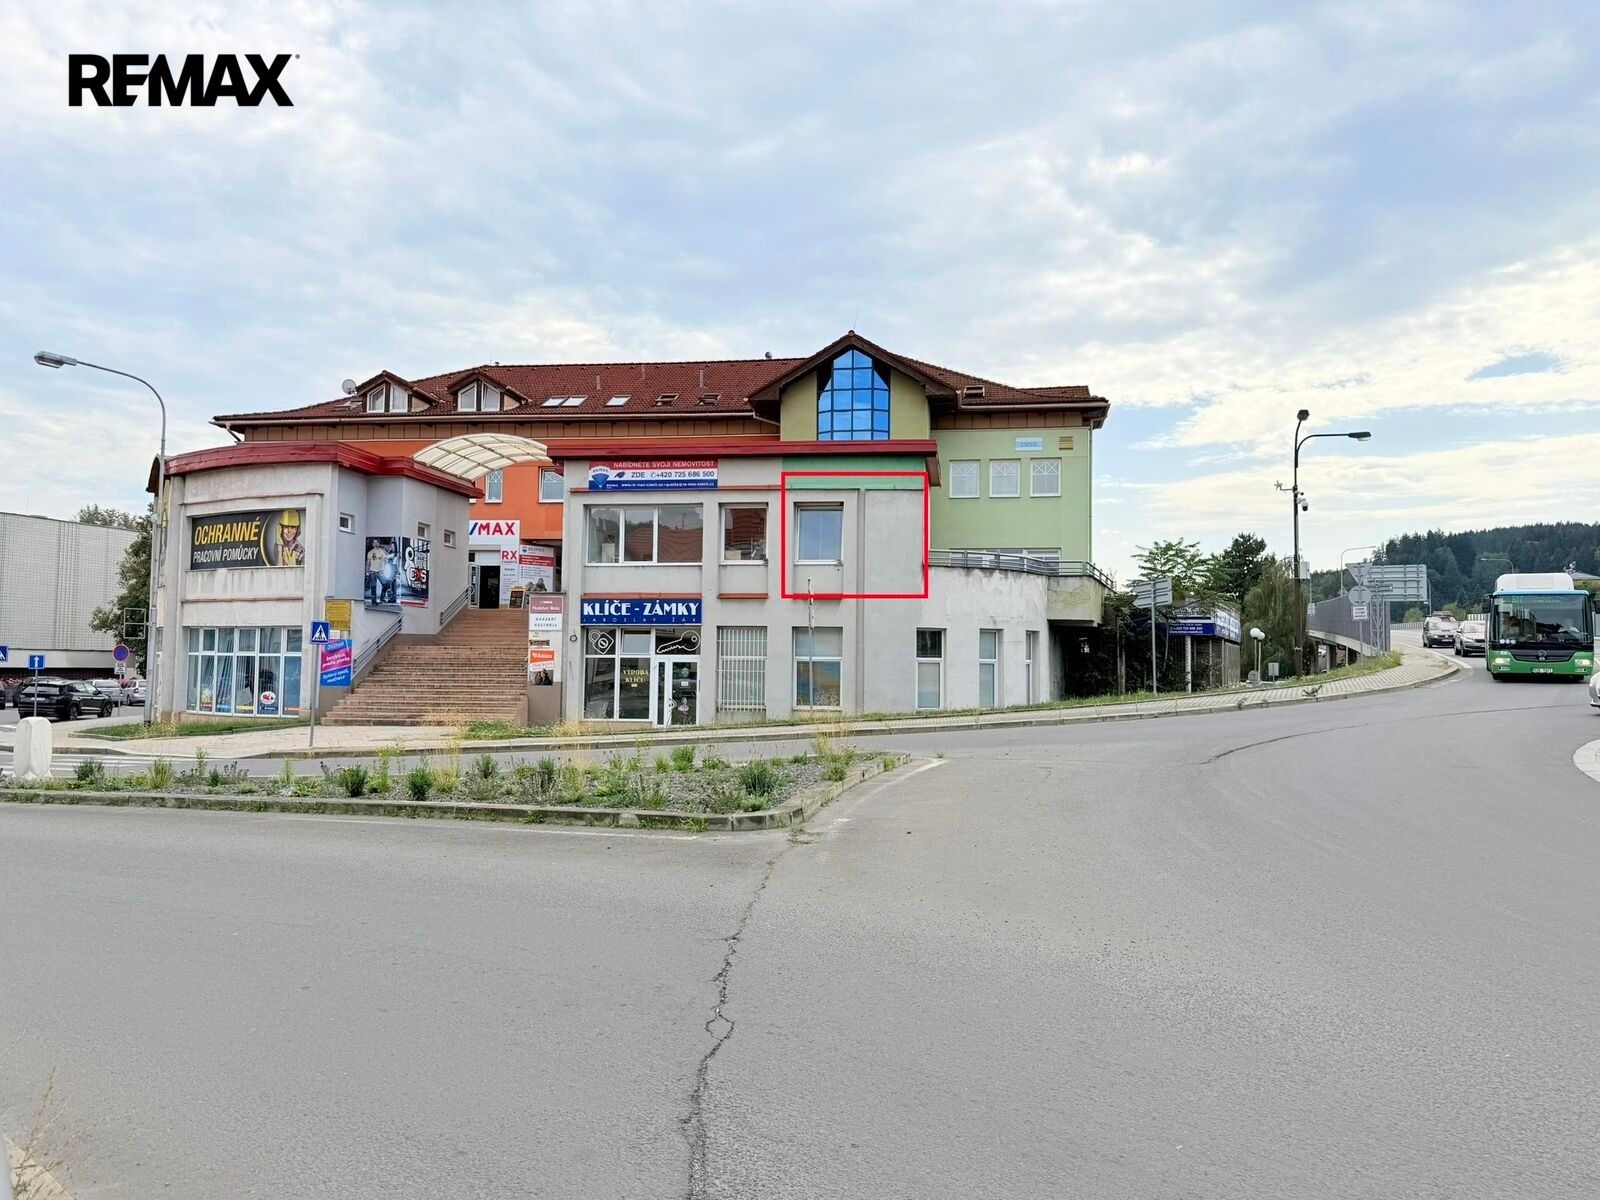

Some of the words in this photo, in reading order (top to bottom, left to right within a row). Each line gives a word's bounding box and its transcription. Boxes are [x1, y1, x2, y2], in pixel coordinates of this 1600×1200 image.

[194, 517, 261, 546] OCHRANNÉ
[193, 546, 222, 563] PRACOVNÍ
[222, 544, 260, 562] POMŮCKY
[502, 550, 518, 560] RX
[583, 599, 631, 616] KLÍČE
[642, 599, 699, 616] ZÁMKY
